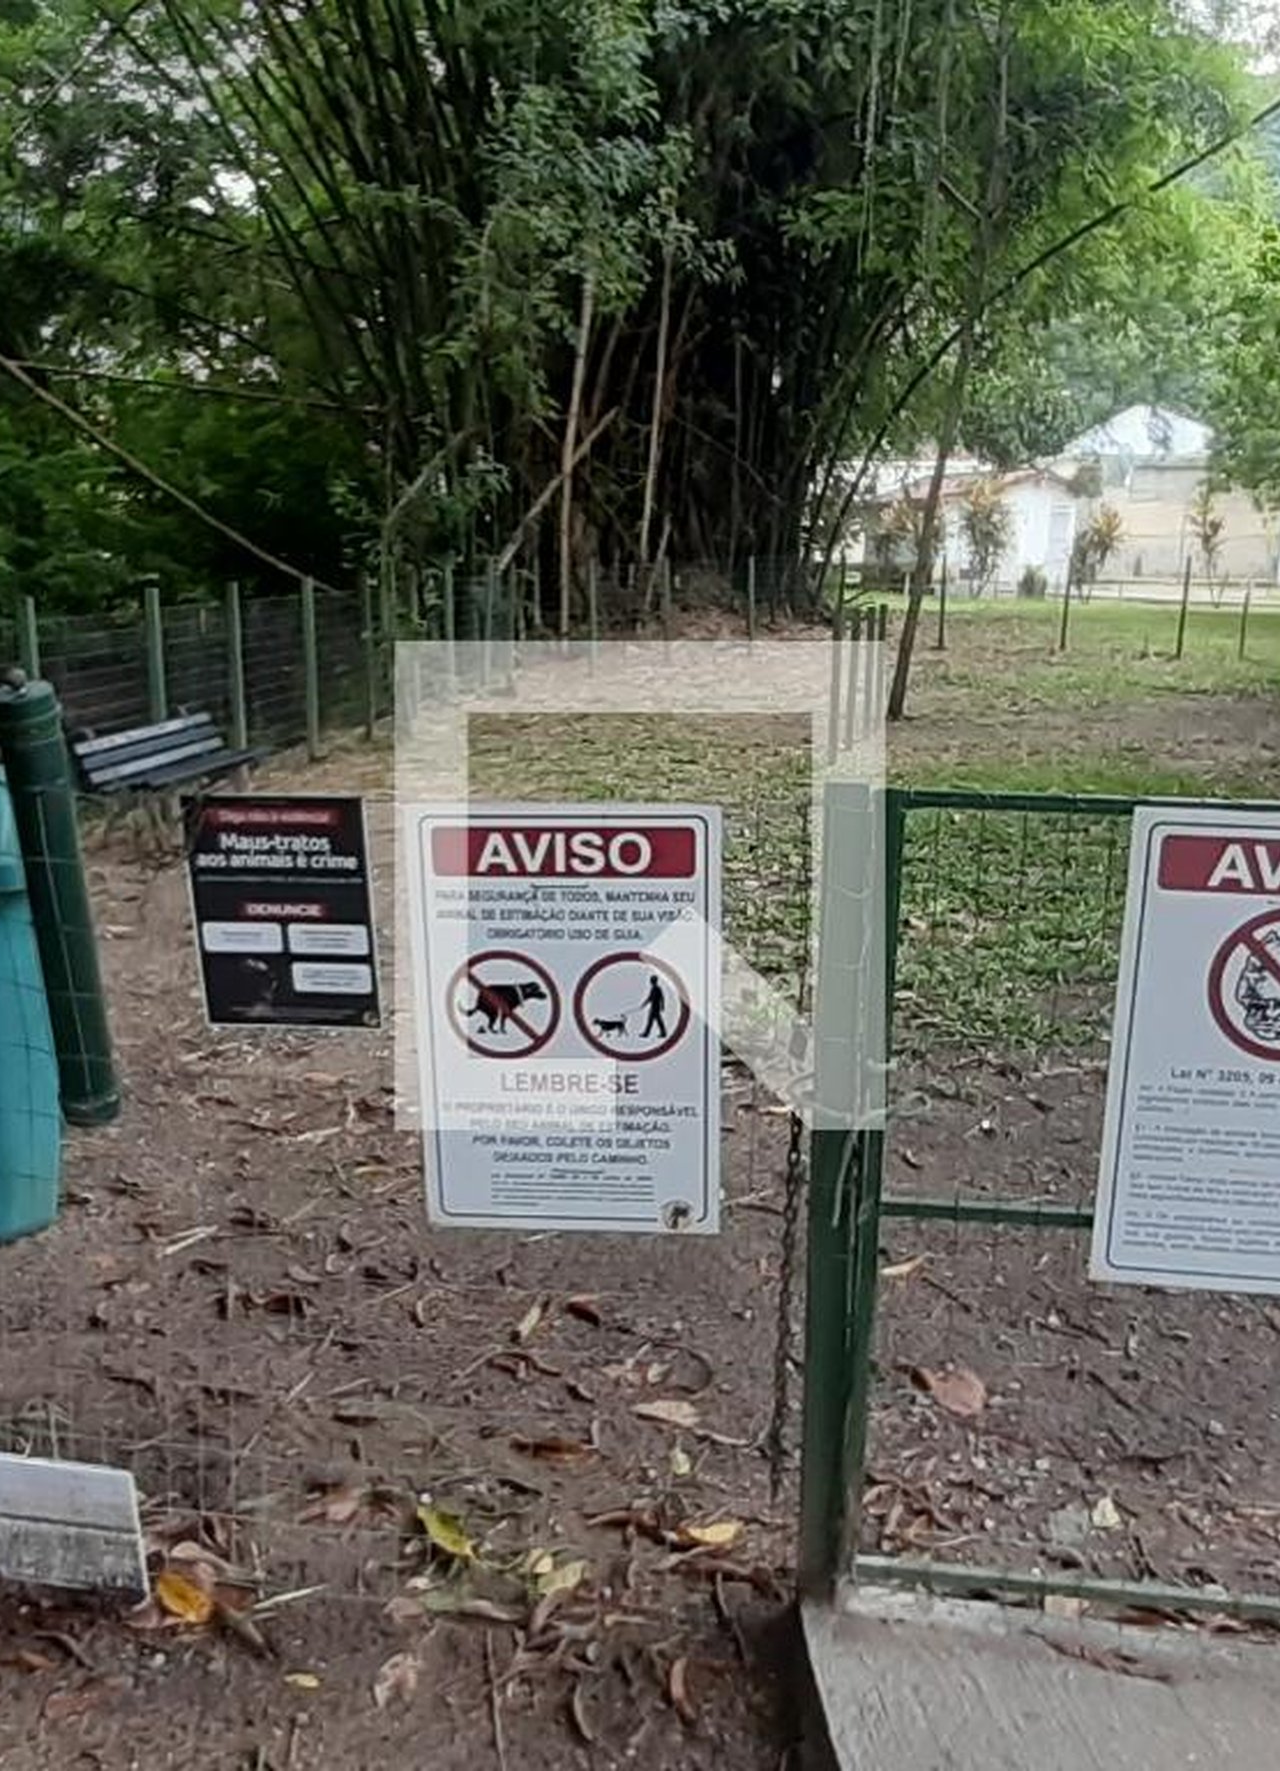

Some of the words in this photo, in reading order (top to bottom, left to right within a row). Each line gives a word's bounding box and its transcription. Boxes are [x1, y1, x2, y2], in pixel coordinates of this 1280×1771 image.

[219, 832, 331, 850] Maus-tratos
[196, 853, 226, 868] aos
[230, 852, 293, 868] animais
[311, 853, 357, 870] crime
[476, 831, 652, 875] AVISO
[246, 903, 322, 917] DENUNCIE
[500, 1072, 639, 1094] LEMBRE-SE
